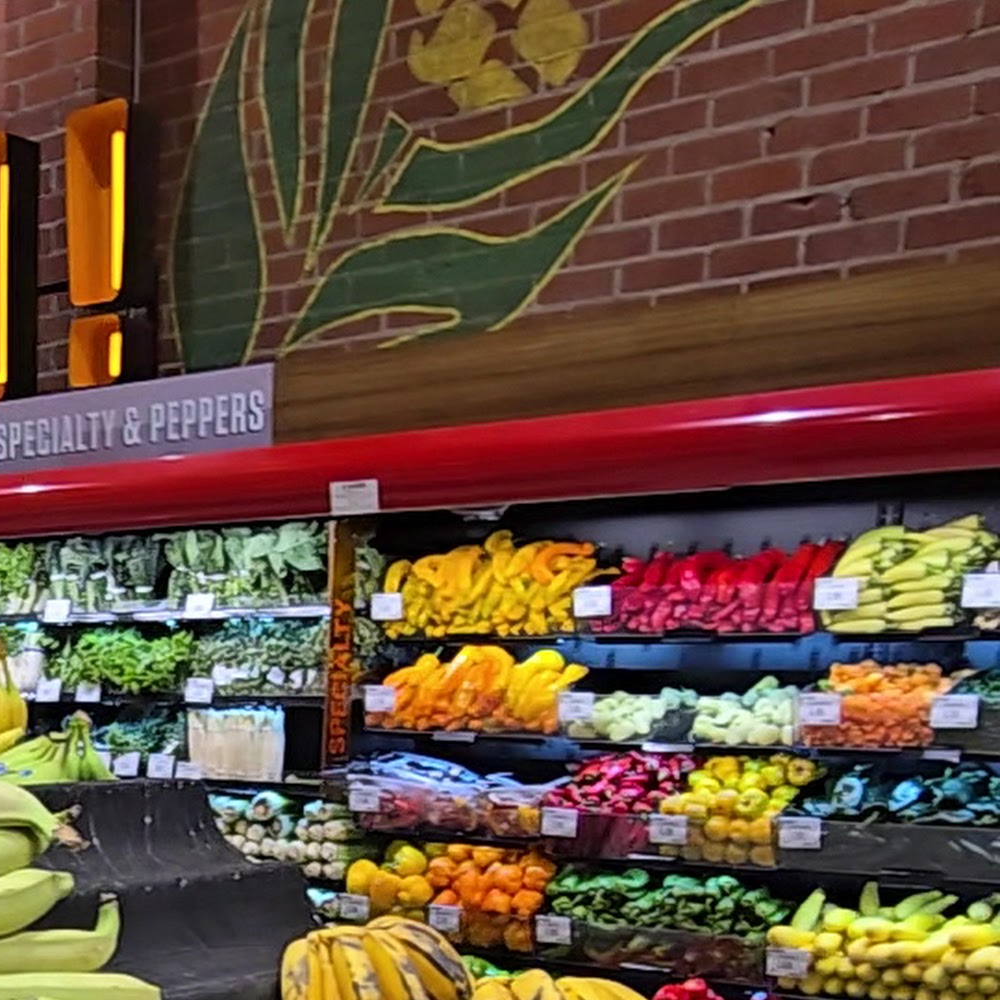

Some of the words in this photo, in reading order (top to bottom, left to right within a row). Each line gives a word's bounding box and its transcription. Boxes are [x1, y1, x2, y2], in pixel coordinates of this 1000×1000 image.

[122, 406, 143, 446] &
[148, 390, 265, 443] PEPPERS
[328, 599, 351, 755] SPECIALTY
